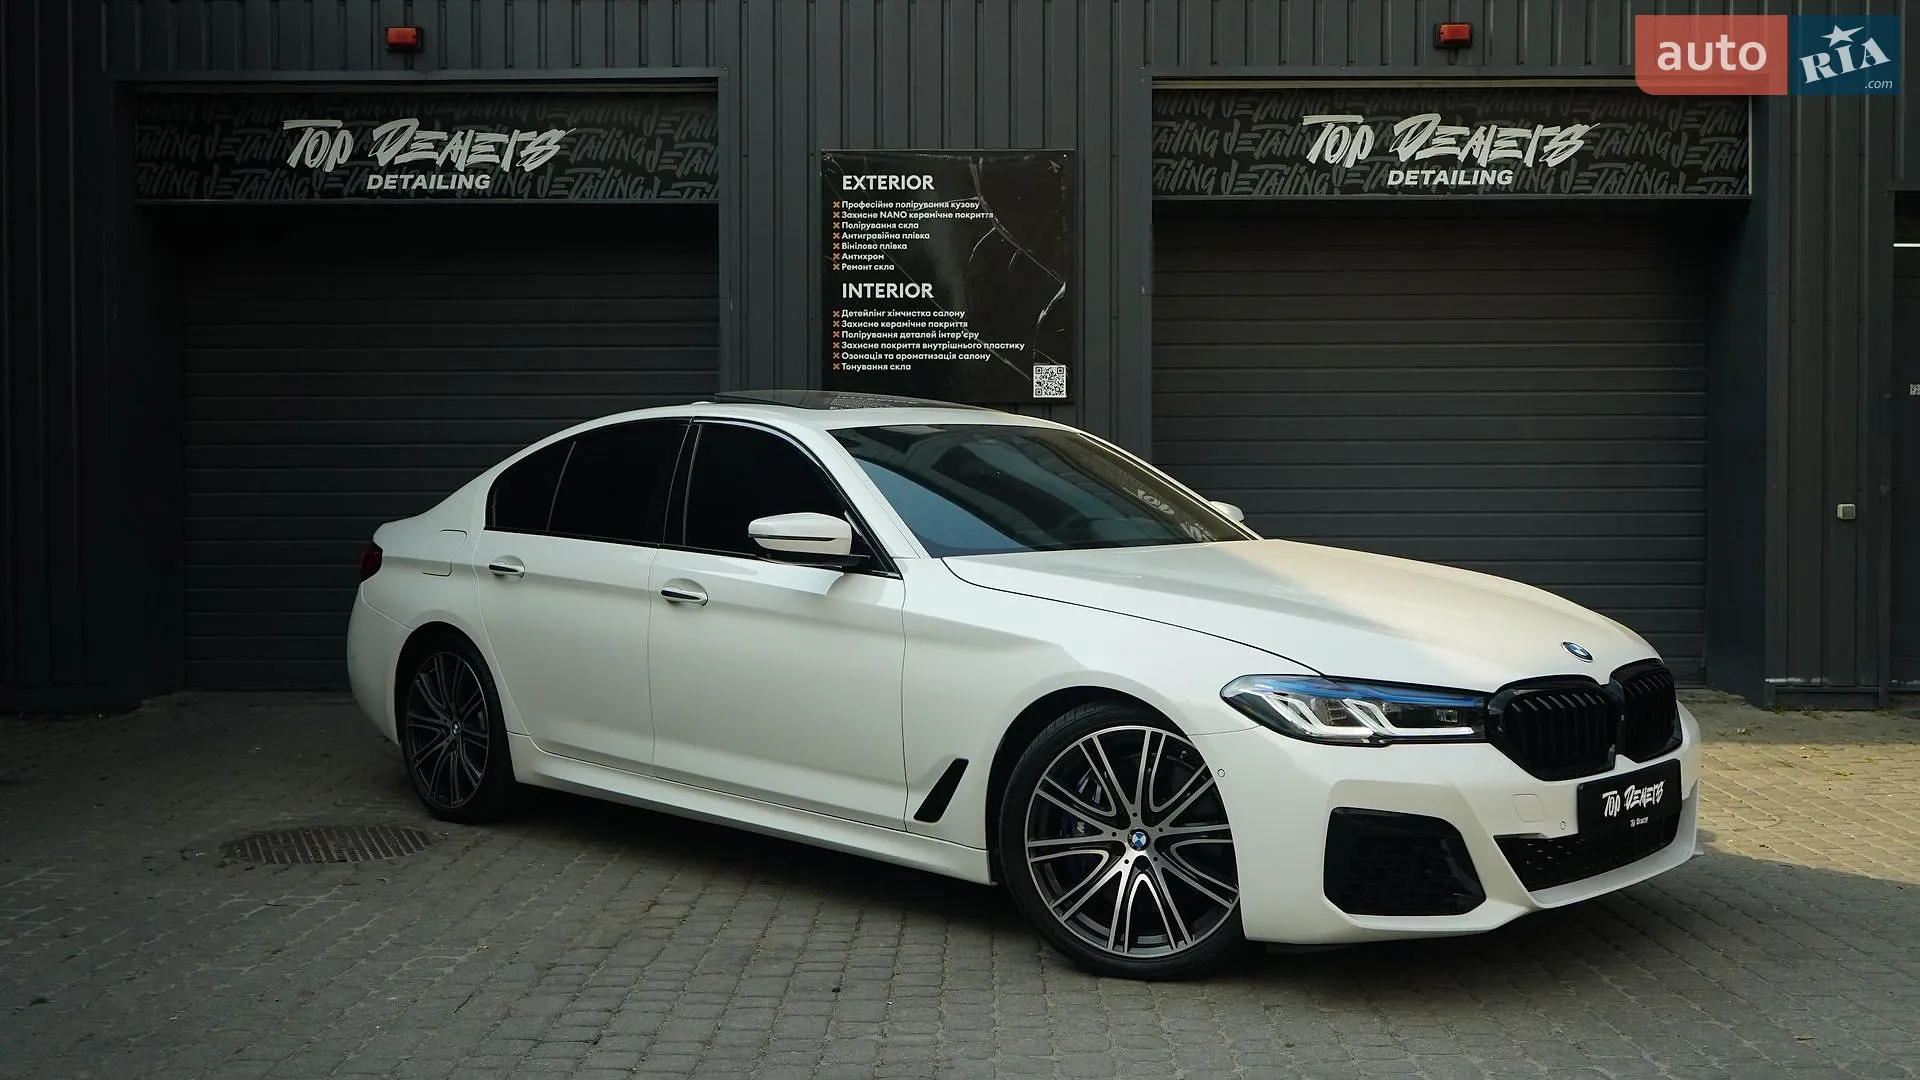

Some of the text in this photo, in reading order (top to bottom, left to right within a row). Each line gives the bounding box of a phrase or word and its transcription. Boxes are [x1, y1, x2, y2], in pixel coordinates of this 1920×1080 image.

[367, 174, 491, 190] DETAILING
[1387, 169, 1514, 185] DETAILING
[842, 175, 935, 190] EXTERIOR
[842, 201, 980, 211] Професійне полірування кузову
[842, 211, 994, 221] Захисне NANO керамічне покриття
[842, 221, 896, 231] Полірування
[841, 231, 930, 241] Антигравійна плівка
[842, 242, 908, 250] Вінілова плівка
[841, 252, 885, 262] Антихром
[842, 263, 873, 271] Ремонт
[842, 283, 935, 299] INTERIOR
[842, 309, 965, 320] Детейлінг хімчистка салону
[842, 320, 968, 330] Захисне керамічне покриття
[842, 330, 980, 341] Полірування деталей інтер’єру
[842, 341, 1026, 352] Захисне покриття внутрішнього пластику
[842, 352, 883, 361] Озонація
[895, 352, 957, 363] ароматизація
[958, 354, 991, 363] салону
[841, 363, 888, 373] Тонування
